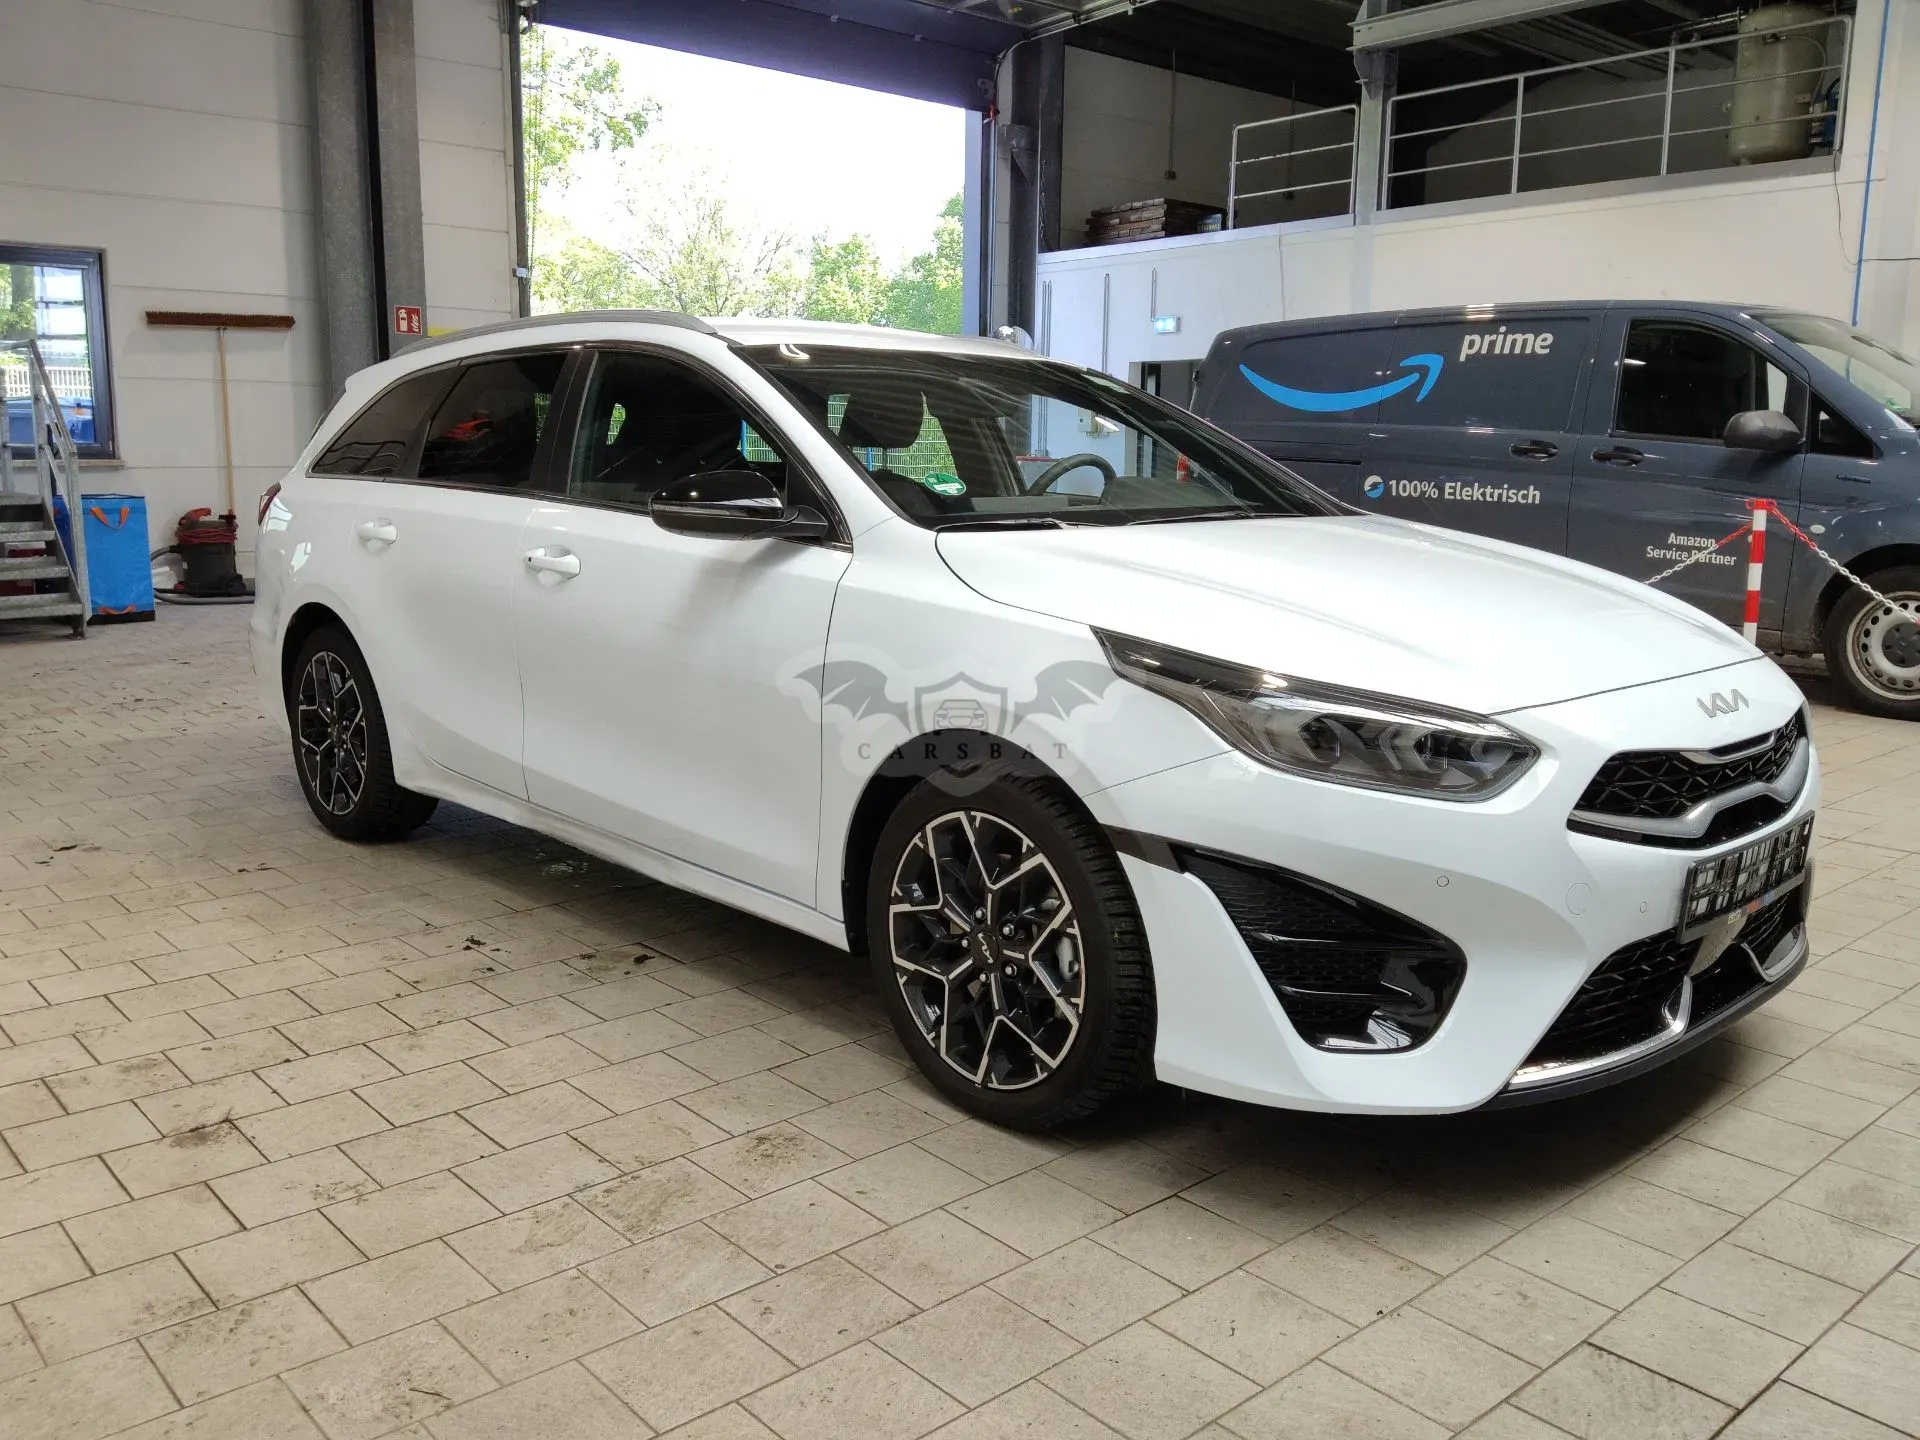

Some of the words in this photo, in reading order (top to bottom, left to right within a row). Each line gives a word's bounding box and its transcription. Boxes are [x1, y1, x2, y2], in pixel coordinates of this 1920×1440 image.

[1459, 326, 1554, 361] prime
[1389, 479, 1439, 499] 100%
[1444, 482, 1541, 504] Elektrisch
[1668, 532, 1716, 548] Amazon
[1646, 546, 1689, 561] Service
